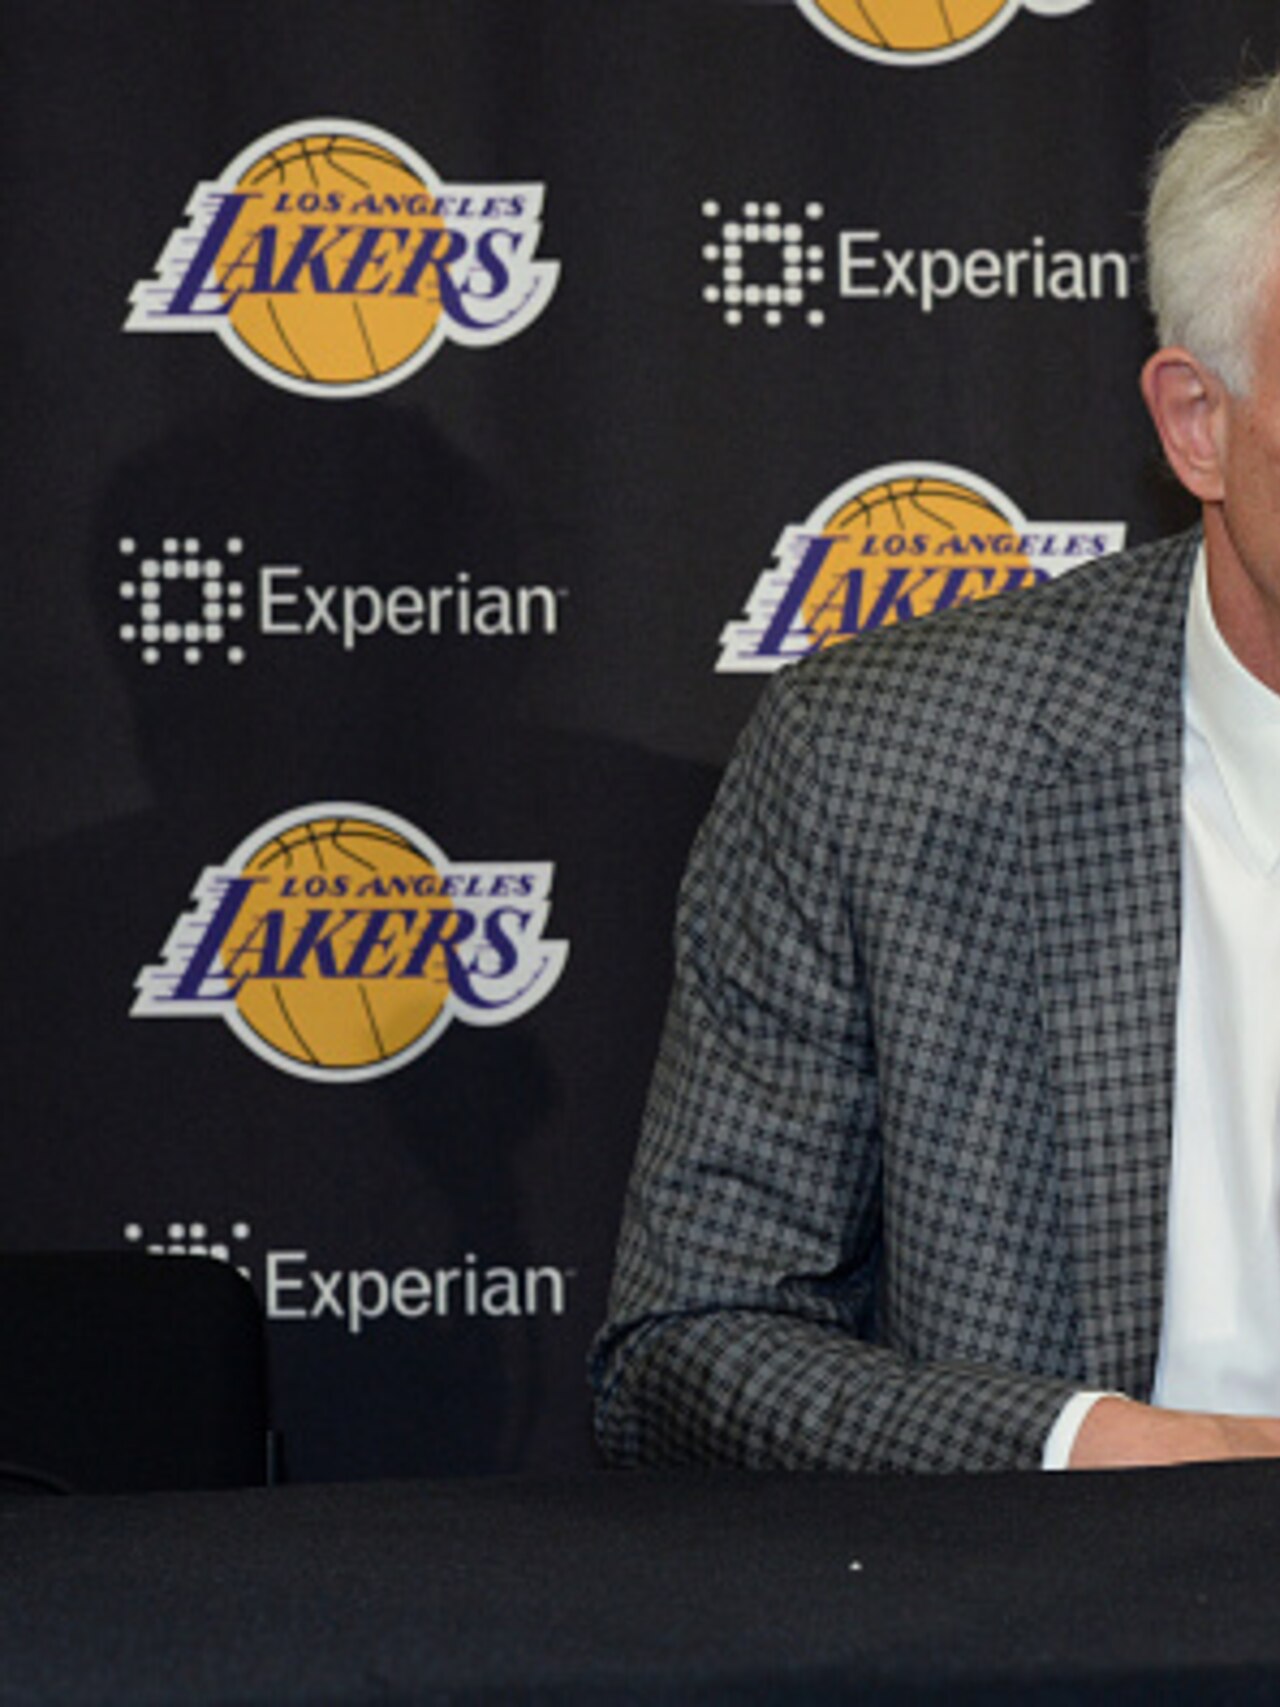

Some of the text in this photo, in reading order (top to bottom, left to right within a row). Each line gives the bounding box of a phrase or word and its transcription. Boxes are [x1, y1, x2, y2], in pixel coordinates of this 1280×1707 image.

[273, 192, 526, 218] LOS ANGELES
[147, 193, 541, 330] LAKERS
[838, 231, 1128, 312] Experian
[859, 533, 1108, 557] LOS ANGELES
[260, 567, 557, 649] Experian
[738, 535, 1052, 658] LAKE
[278, 874, 537, 898] LOS ANGELES
[152, 876, 550, 1010] LAKERS
[266, 1252, 564, 1333] Experian
